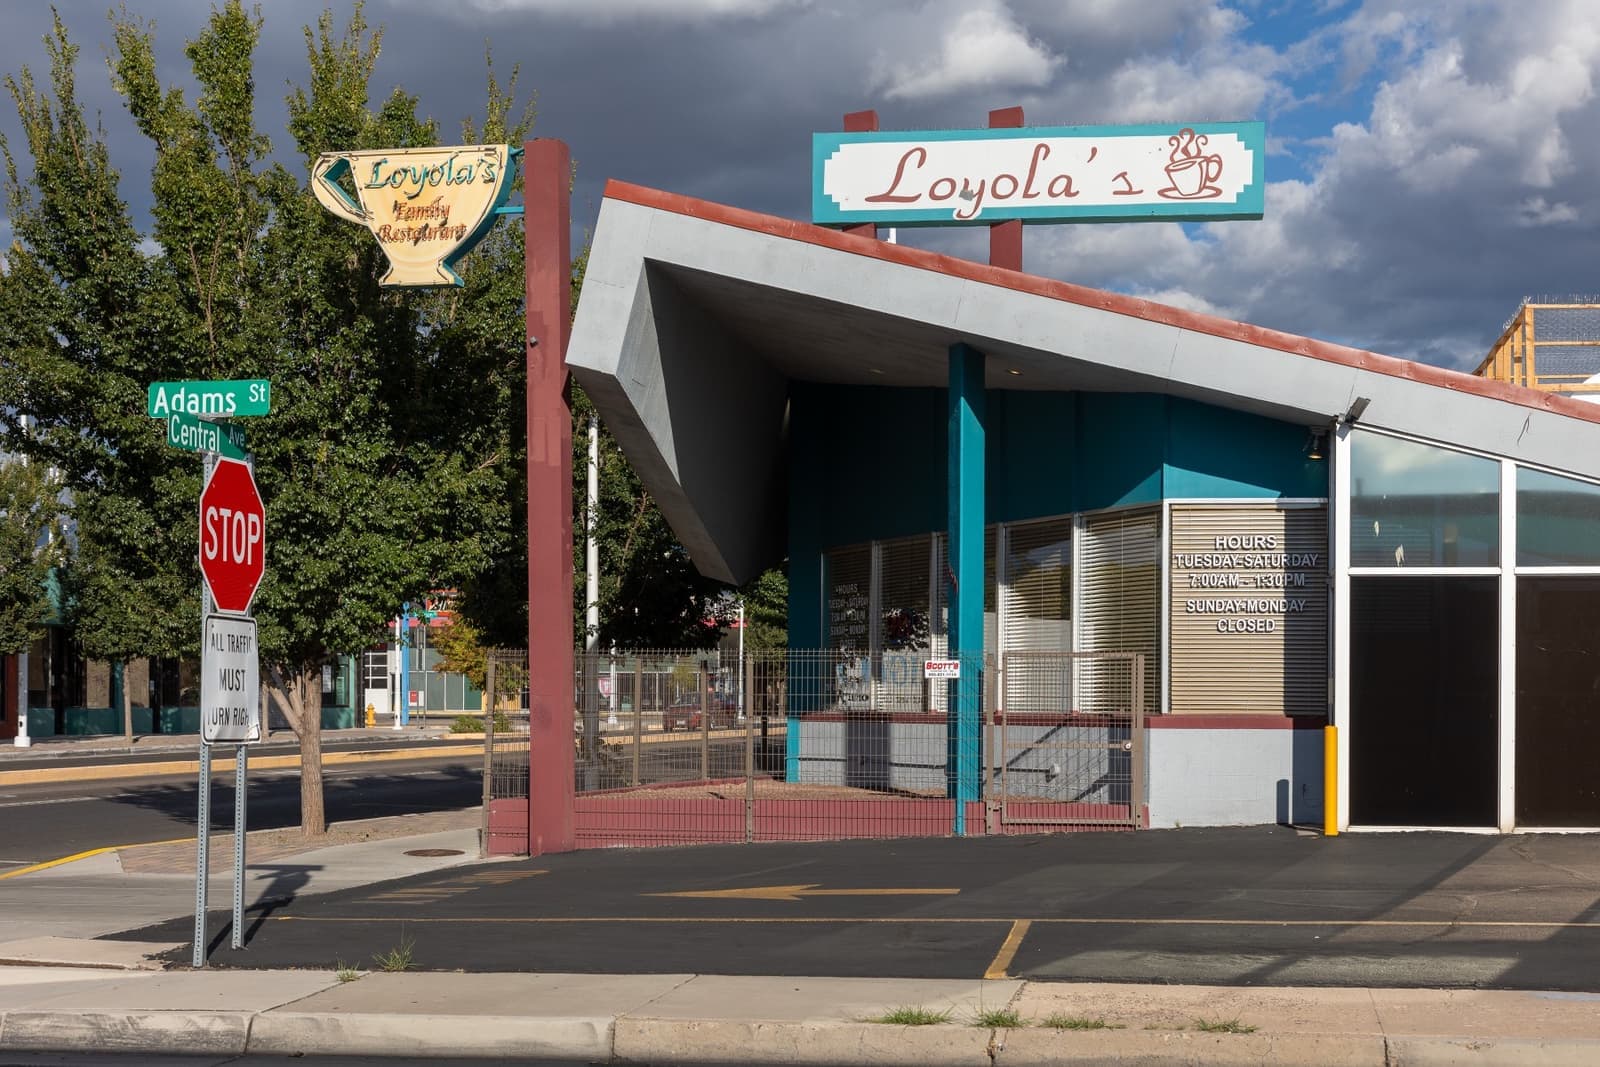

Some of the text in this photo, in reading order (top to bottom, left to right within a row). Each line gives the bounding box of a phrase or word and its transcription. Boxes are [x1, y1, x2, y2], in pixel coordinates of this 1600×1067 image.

[364, 151, 498, 200] Loyola's
[864, 143, 1144, 219] Loyola's
[393, 197, 450, 224] Family
[379, 223, 467, 245] Restaurant
[154, 384, 266, 414] Adams St
[171, 414, 245, 452] Central Ave
[205, 506, 261, 566] STOP
[1215, 535, 1277, 550] HOURS
[1175, 554, 1318, 568] TUESDAY-SATURDAY
[1190, 573, 1240, 587] 7:00AM
[1255, 573, 1305, 587] 1:30PM
[1186, 599, 1306, 614] SUNDAY-MONDAY
[1217, 618, 1276, 632] CLOSED
[211, 633, 224, 652] ALL
[219, 668, 246, 692] MUST
[233, 708, 250, 726] RIGH
